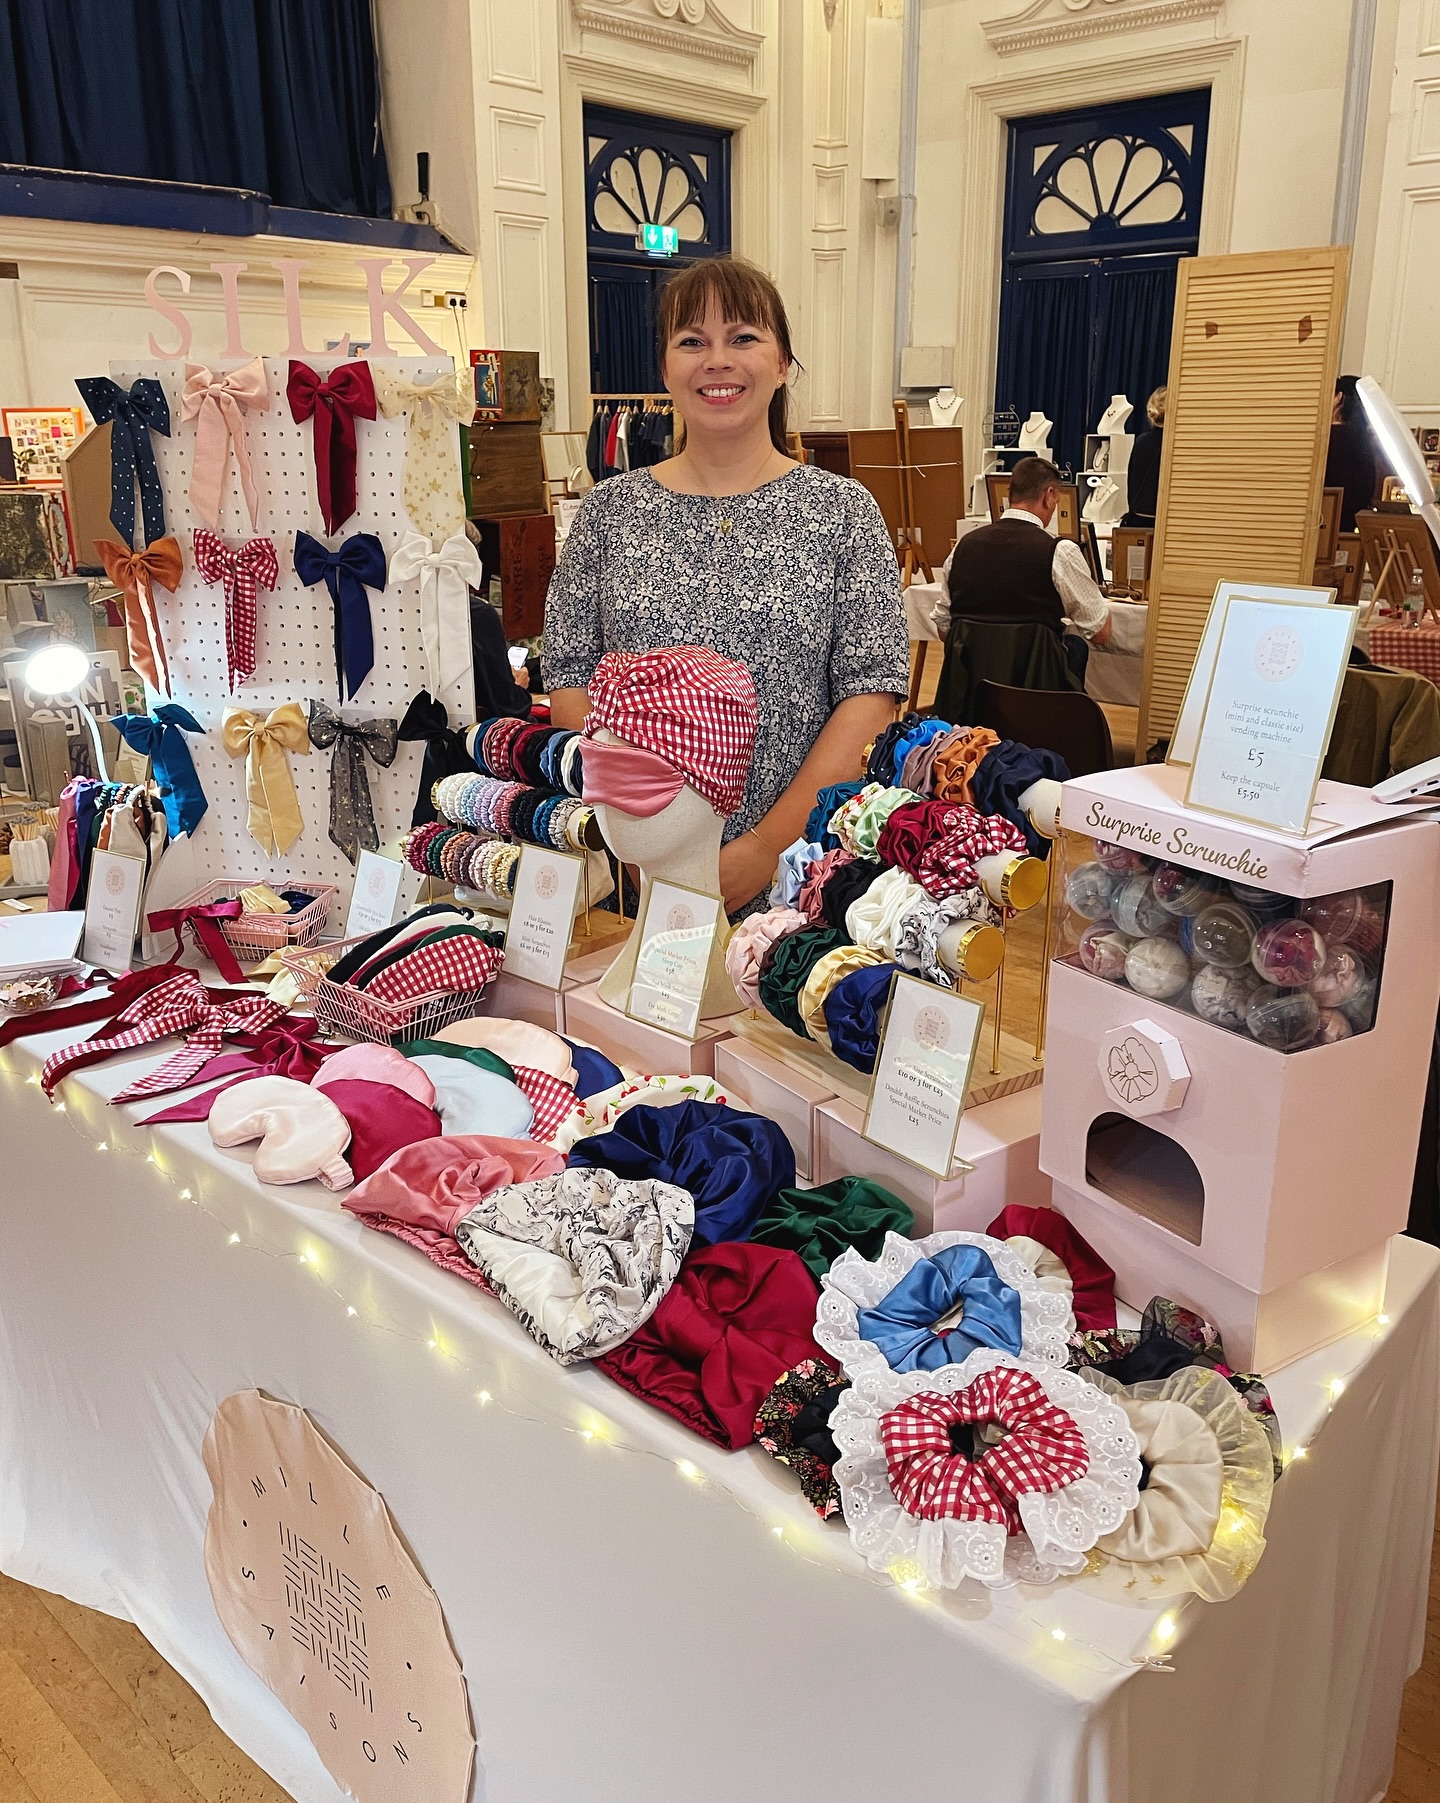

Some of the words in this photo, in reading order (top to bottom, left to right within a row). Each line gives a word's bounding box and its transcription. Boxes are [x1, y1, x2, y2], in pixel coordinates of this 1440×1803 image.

[144, 258, 447, 360] SILK
[1232, 700, 1262, 712] Surprise
[1263, 707, 1299, 719] scrunchie
[1225, 711, 1244, 721] (mini
[1246, 716, 1259, 724] and
[1261, 718, 1284, 729] classic
[1286, 723, 1304, 733] size)
[1231, 726, 1259, 739] vending
[1261, 733, 1292, 743] machine
[1248, 748, 1264, 768] £5
[1221, 771, 1238, 784] Keep
[1240, 776, 1251, 785] the
[1253, 780, 1280, 791] capsule
[1238, 788, 1259, 801] £5.50
[1086, 802, 1161, 844] Surprise
[1166, 827, 1268, 878] Scrunchie
[674, 961, 683, 970] Cap
[898, 1069, 908, 1078] £10
[922, 1080, 932, 1090] for
[933, 1086, 944, 1097] £25
[885, 1083, 903, 1096] Double
[921, 1100, 949, 1119] Scrunchies
[889, 1095, 908, 1109] Special
[908, 1104, 927, 1118] Market
[928, 1114, 942, 1125] Price
[908, 1115, 919, 1126] £25
